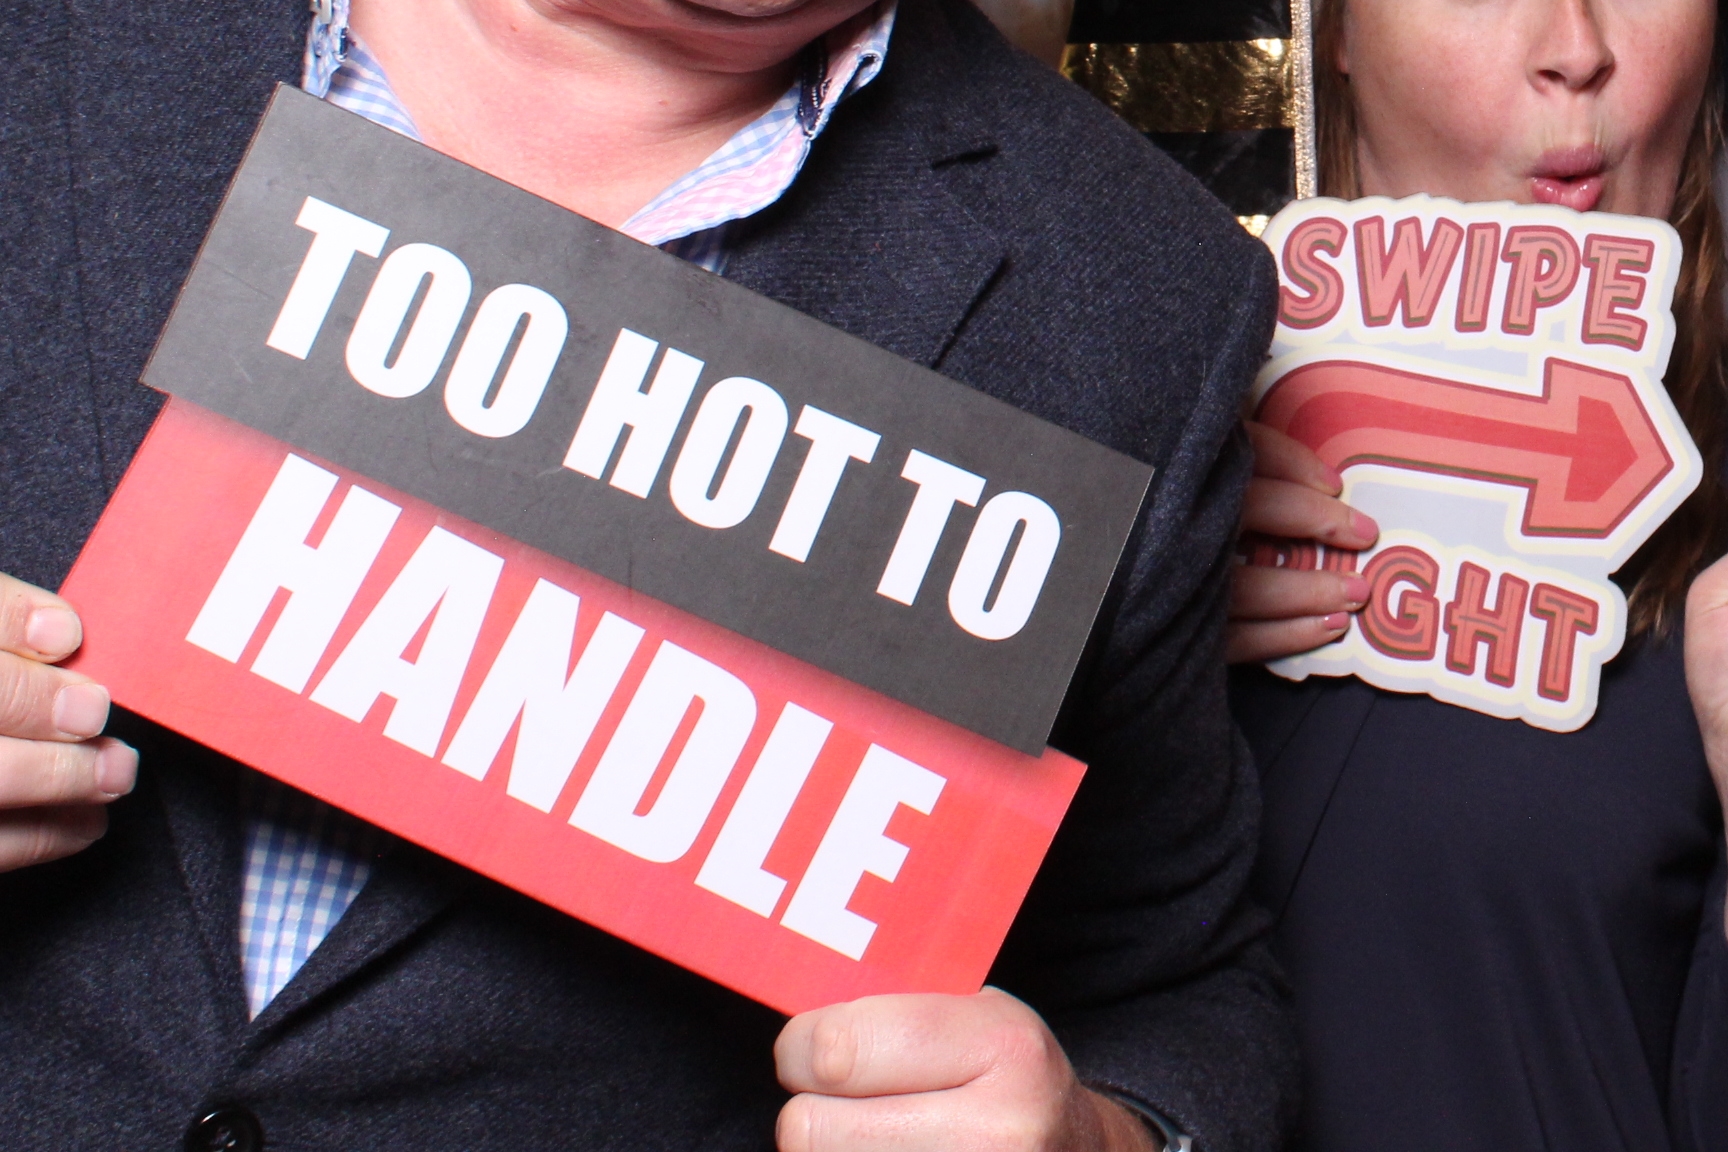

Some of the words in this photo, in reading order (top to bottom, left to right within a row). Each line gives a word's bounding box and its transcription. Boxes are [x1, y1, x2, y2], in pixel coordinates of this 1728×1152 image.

[267, 196, 567, 437] TOO
[563, 328, 881, 562] HOT
[877, 449, 1060, 639] TO
[1279, 214, 1655, 352] SWIPE
[185, 453, 946, 961] HANDLE
[1236, 531, 1599, 703] GHT
